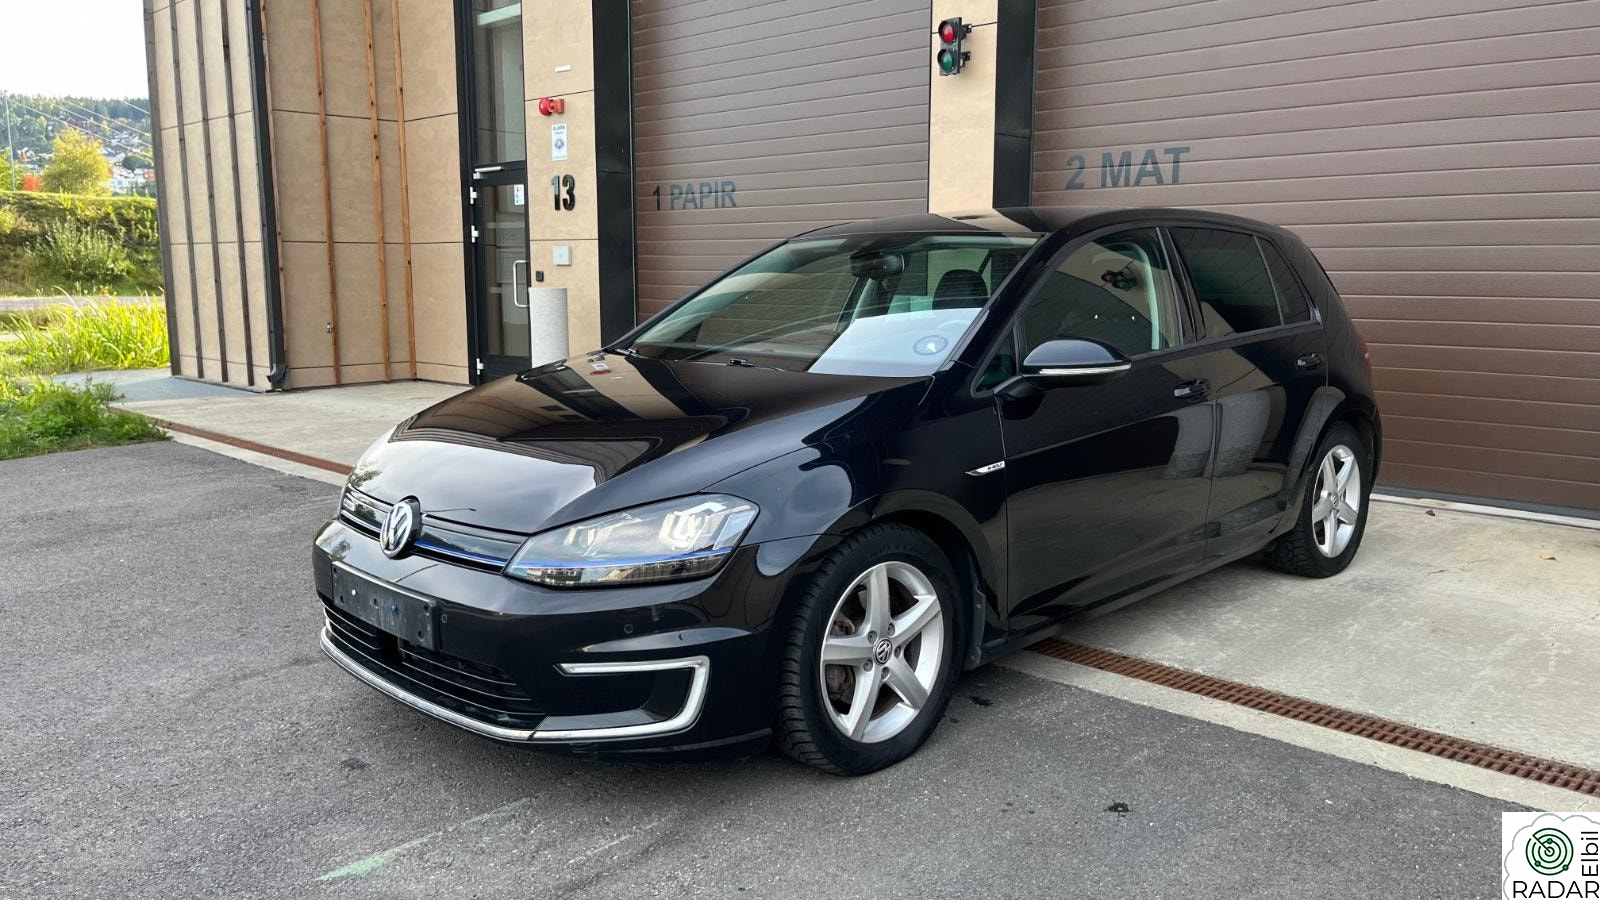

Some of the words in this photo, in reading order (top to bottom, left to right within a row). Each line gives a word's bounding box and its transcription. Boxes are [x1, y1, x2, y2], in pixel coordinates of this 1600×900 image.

[1065, 154, 1086, 190] 2
[1101, 146, 1190, 188] MAT
[551, 174, 575, 211] 13
[652, 185, 660, 211] 1
[670, 181, 736, 210] PAPIR
